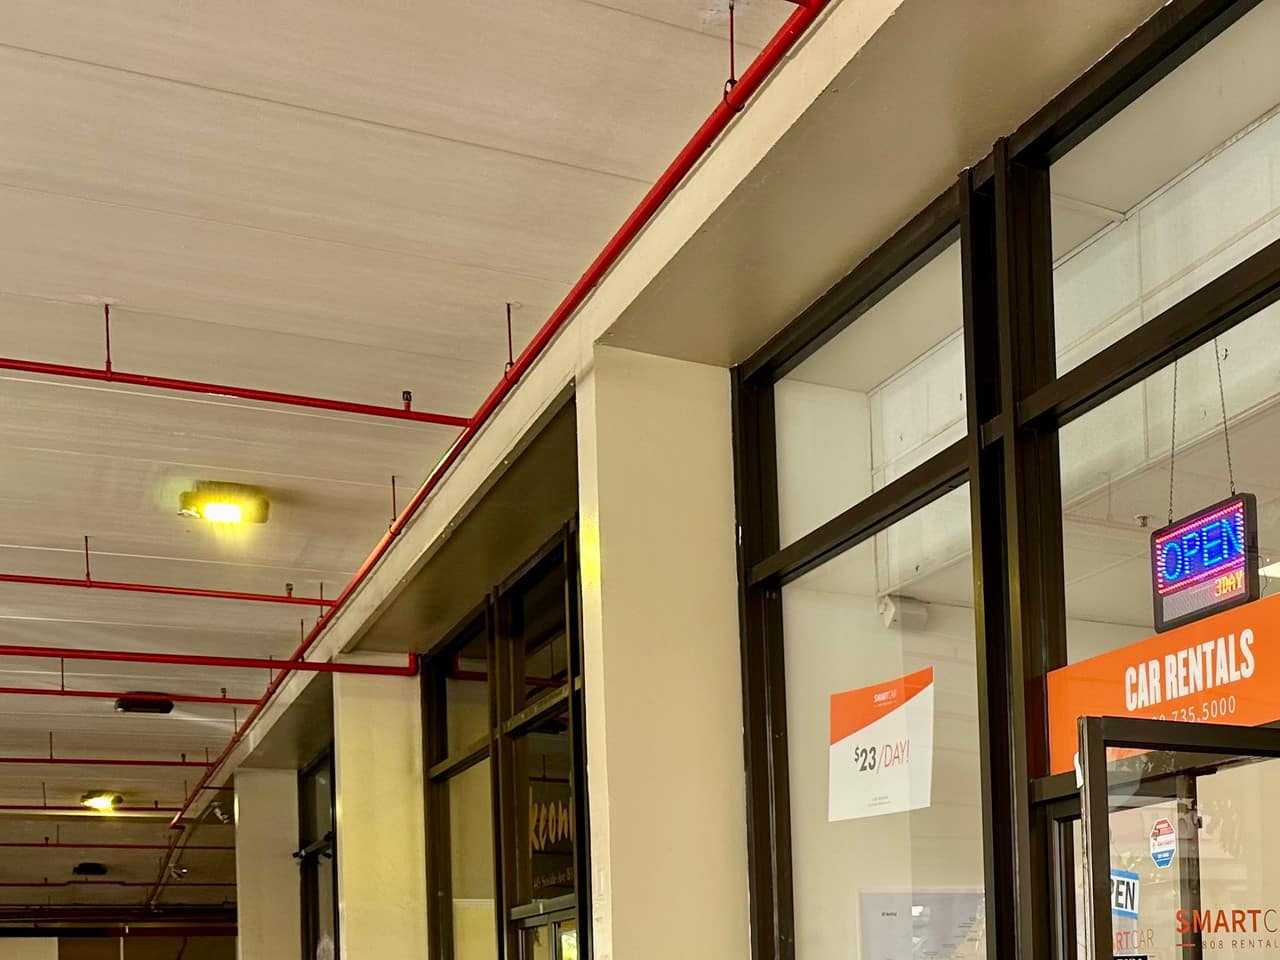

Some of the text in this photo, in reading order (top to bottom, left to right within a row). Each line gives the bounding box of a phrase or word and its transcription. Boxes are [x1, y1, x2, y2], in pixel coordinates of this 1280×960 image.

[1161, 512, 1244, 580] OPEN
[1125, 628, 1255, 711] CAR RENTALS
[1202, 939, 1224, 950] 808
